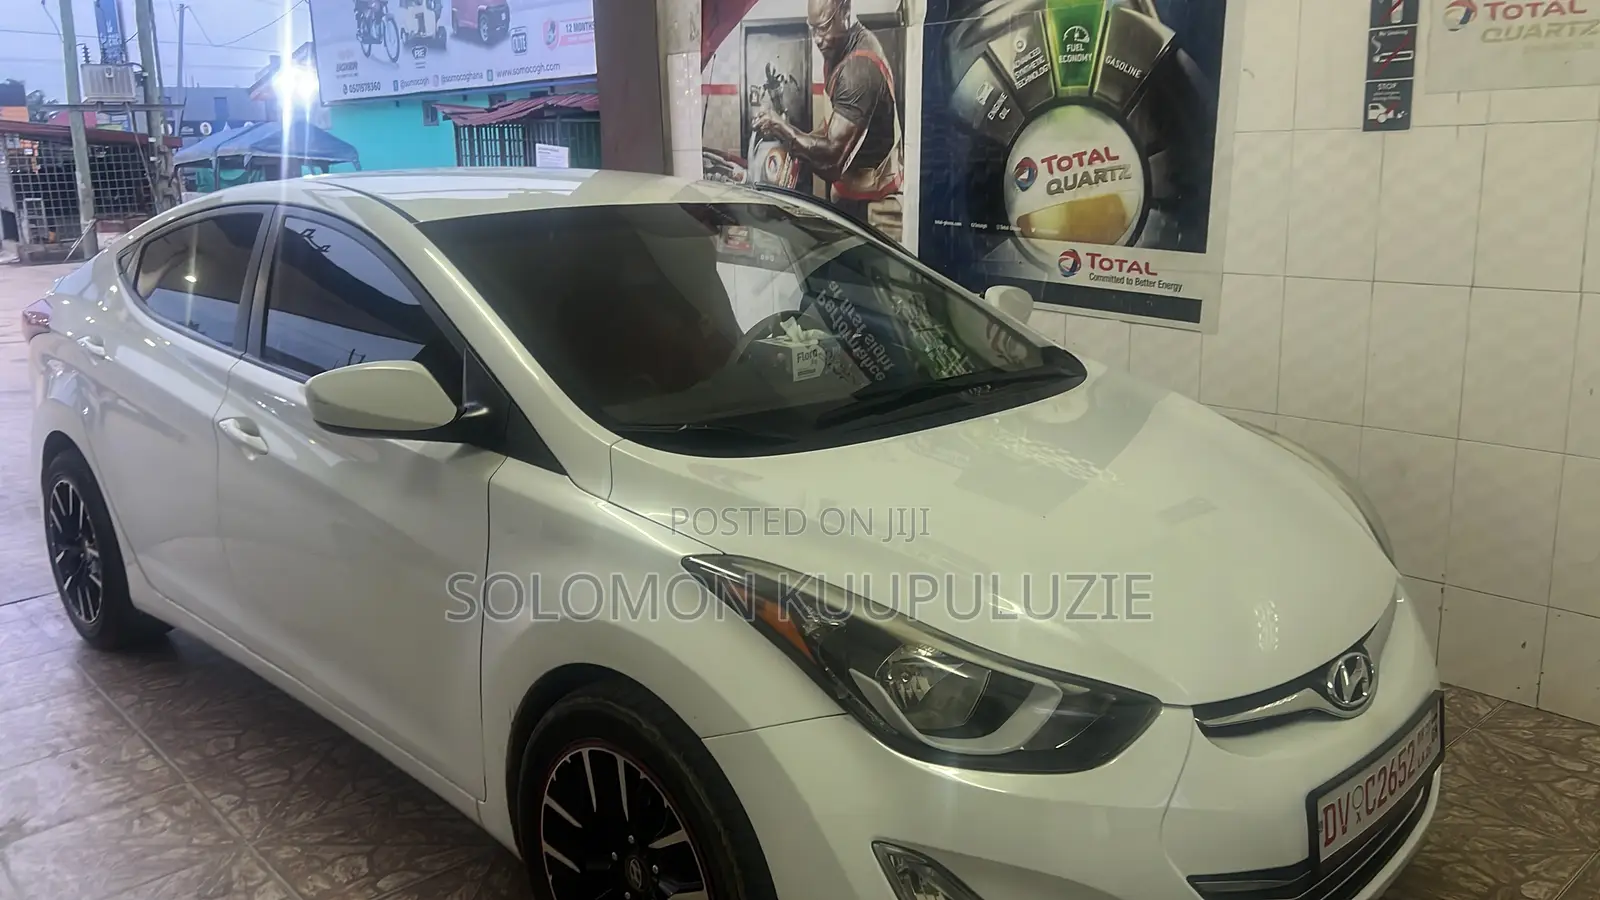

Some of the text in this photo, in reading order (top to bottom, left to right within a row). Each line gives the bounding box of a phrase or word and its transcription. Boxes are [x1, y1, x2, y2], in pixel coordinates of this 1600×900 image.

[1483, 0, 1588, 21] TOTAL
[565, 24, 572, 33] 12
[1480, 18, 1600, 43] QUARTZ
[1058, 53, 1093, 63] ECONOMY
[1066, 43, 1085, 53] FUEL
[496, 62, 560, 78] www.somocogh.com
[1014, 55, 1045, 79] SYNTHETIC
[1105, 55, 1143, 78] GASOLINE
[987, 92, 1008, 120] ENGINE
[1040, 146, 1120, 175] TOTAL
[1046, 164, 1132, 196] QUARTZ
[1085, 252, 1158, 276] TOTAL
[1088, 272, 1183, 292] Committed to Better Energy
[796, 348, 818, 363] Flora
[1322, 739, 1416, 848] DV C2652
